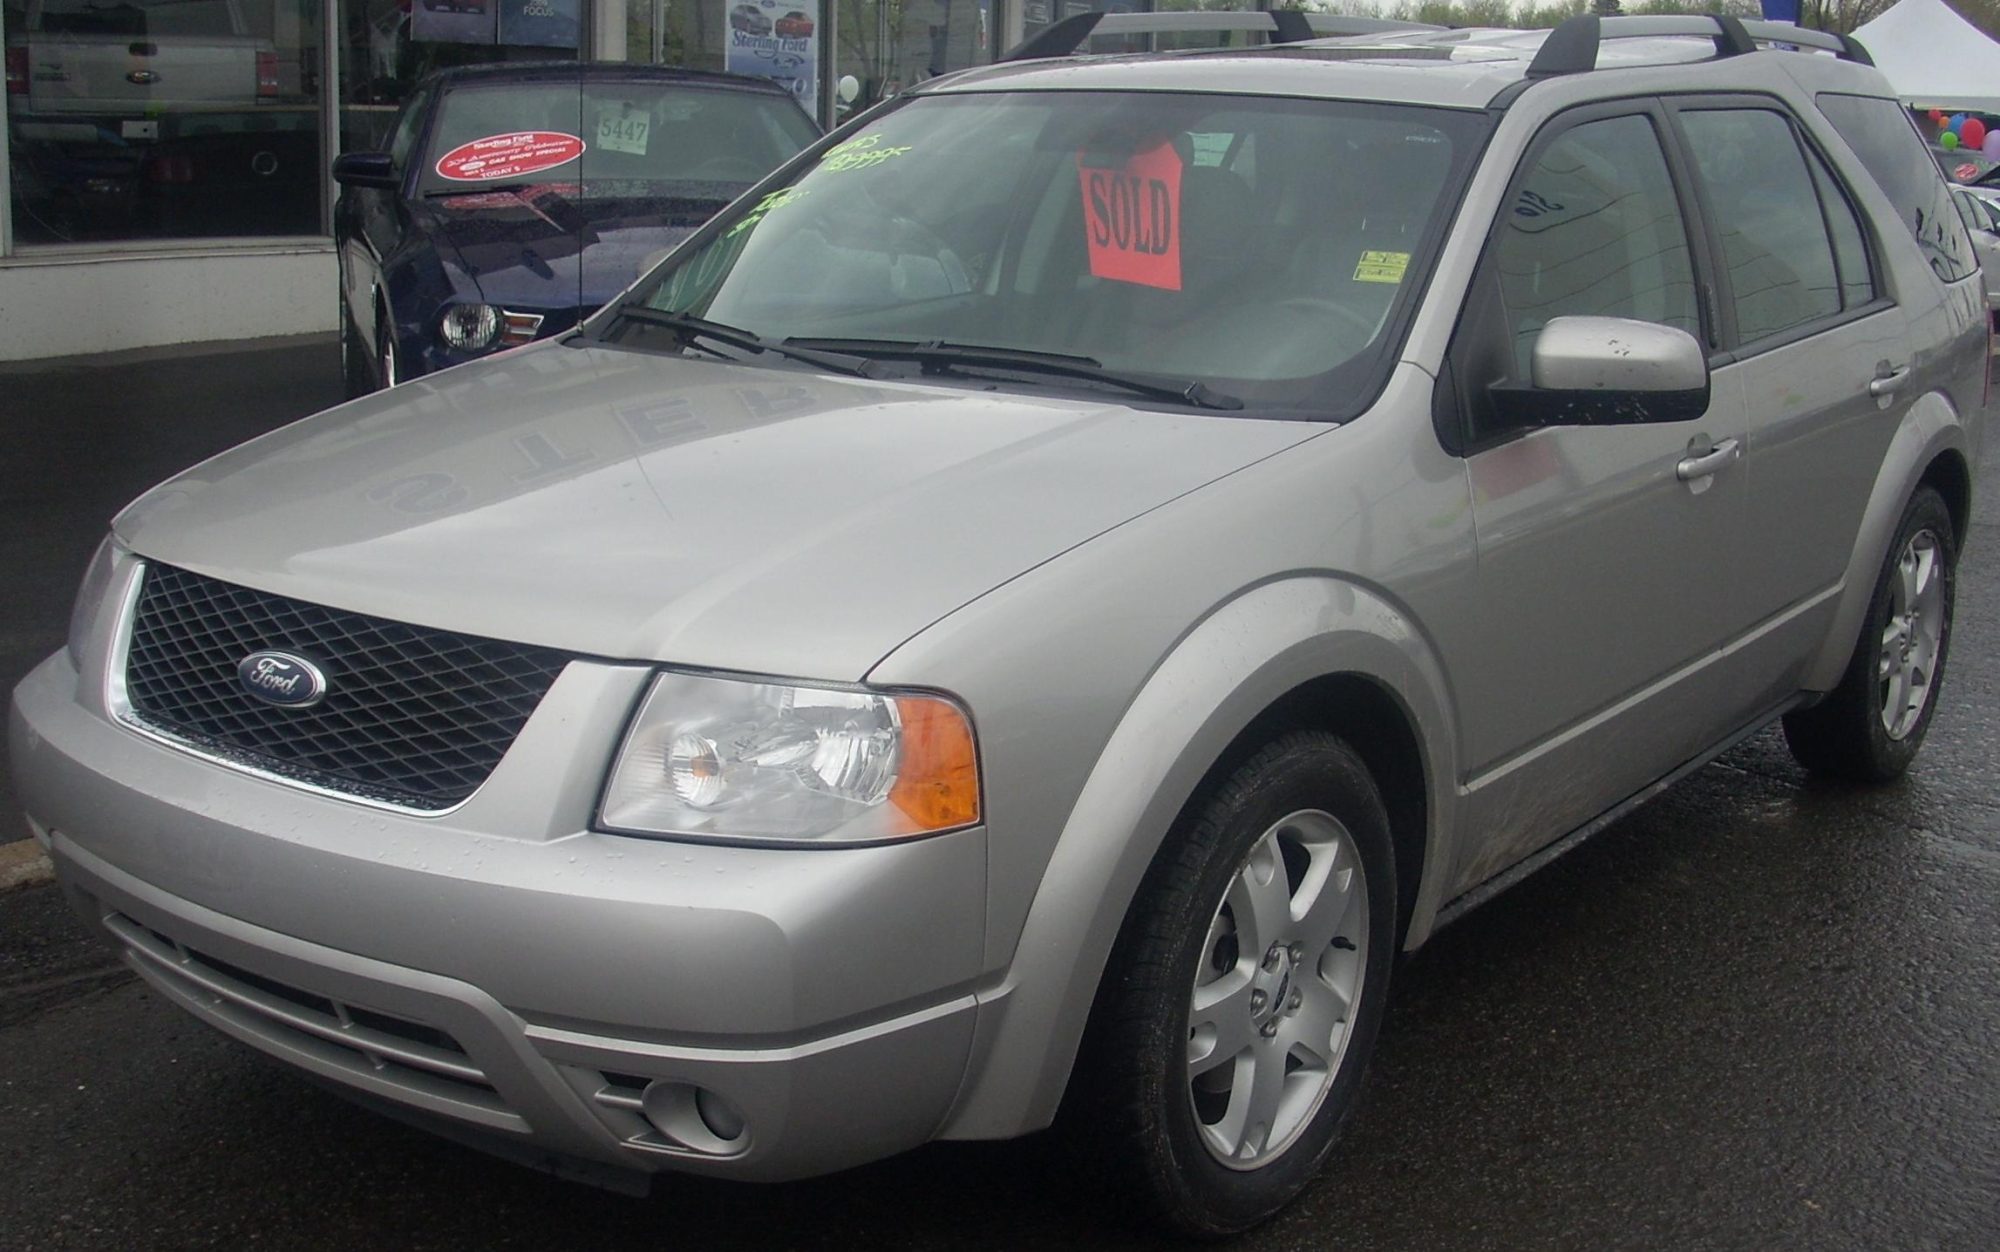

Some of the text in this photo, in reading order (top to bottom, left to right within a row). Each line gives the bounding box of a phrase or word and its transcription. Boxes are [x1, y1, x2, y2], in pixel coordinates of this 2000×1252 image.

[523, 6, 555, 16] FOCUS
[732, 30, 809, 54] Sterling Ford
[601, 119, 648, 141] 5447
[1090, 173, 1171, 256] SOLD
[250, 657, 300, 695] Ford
